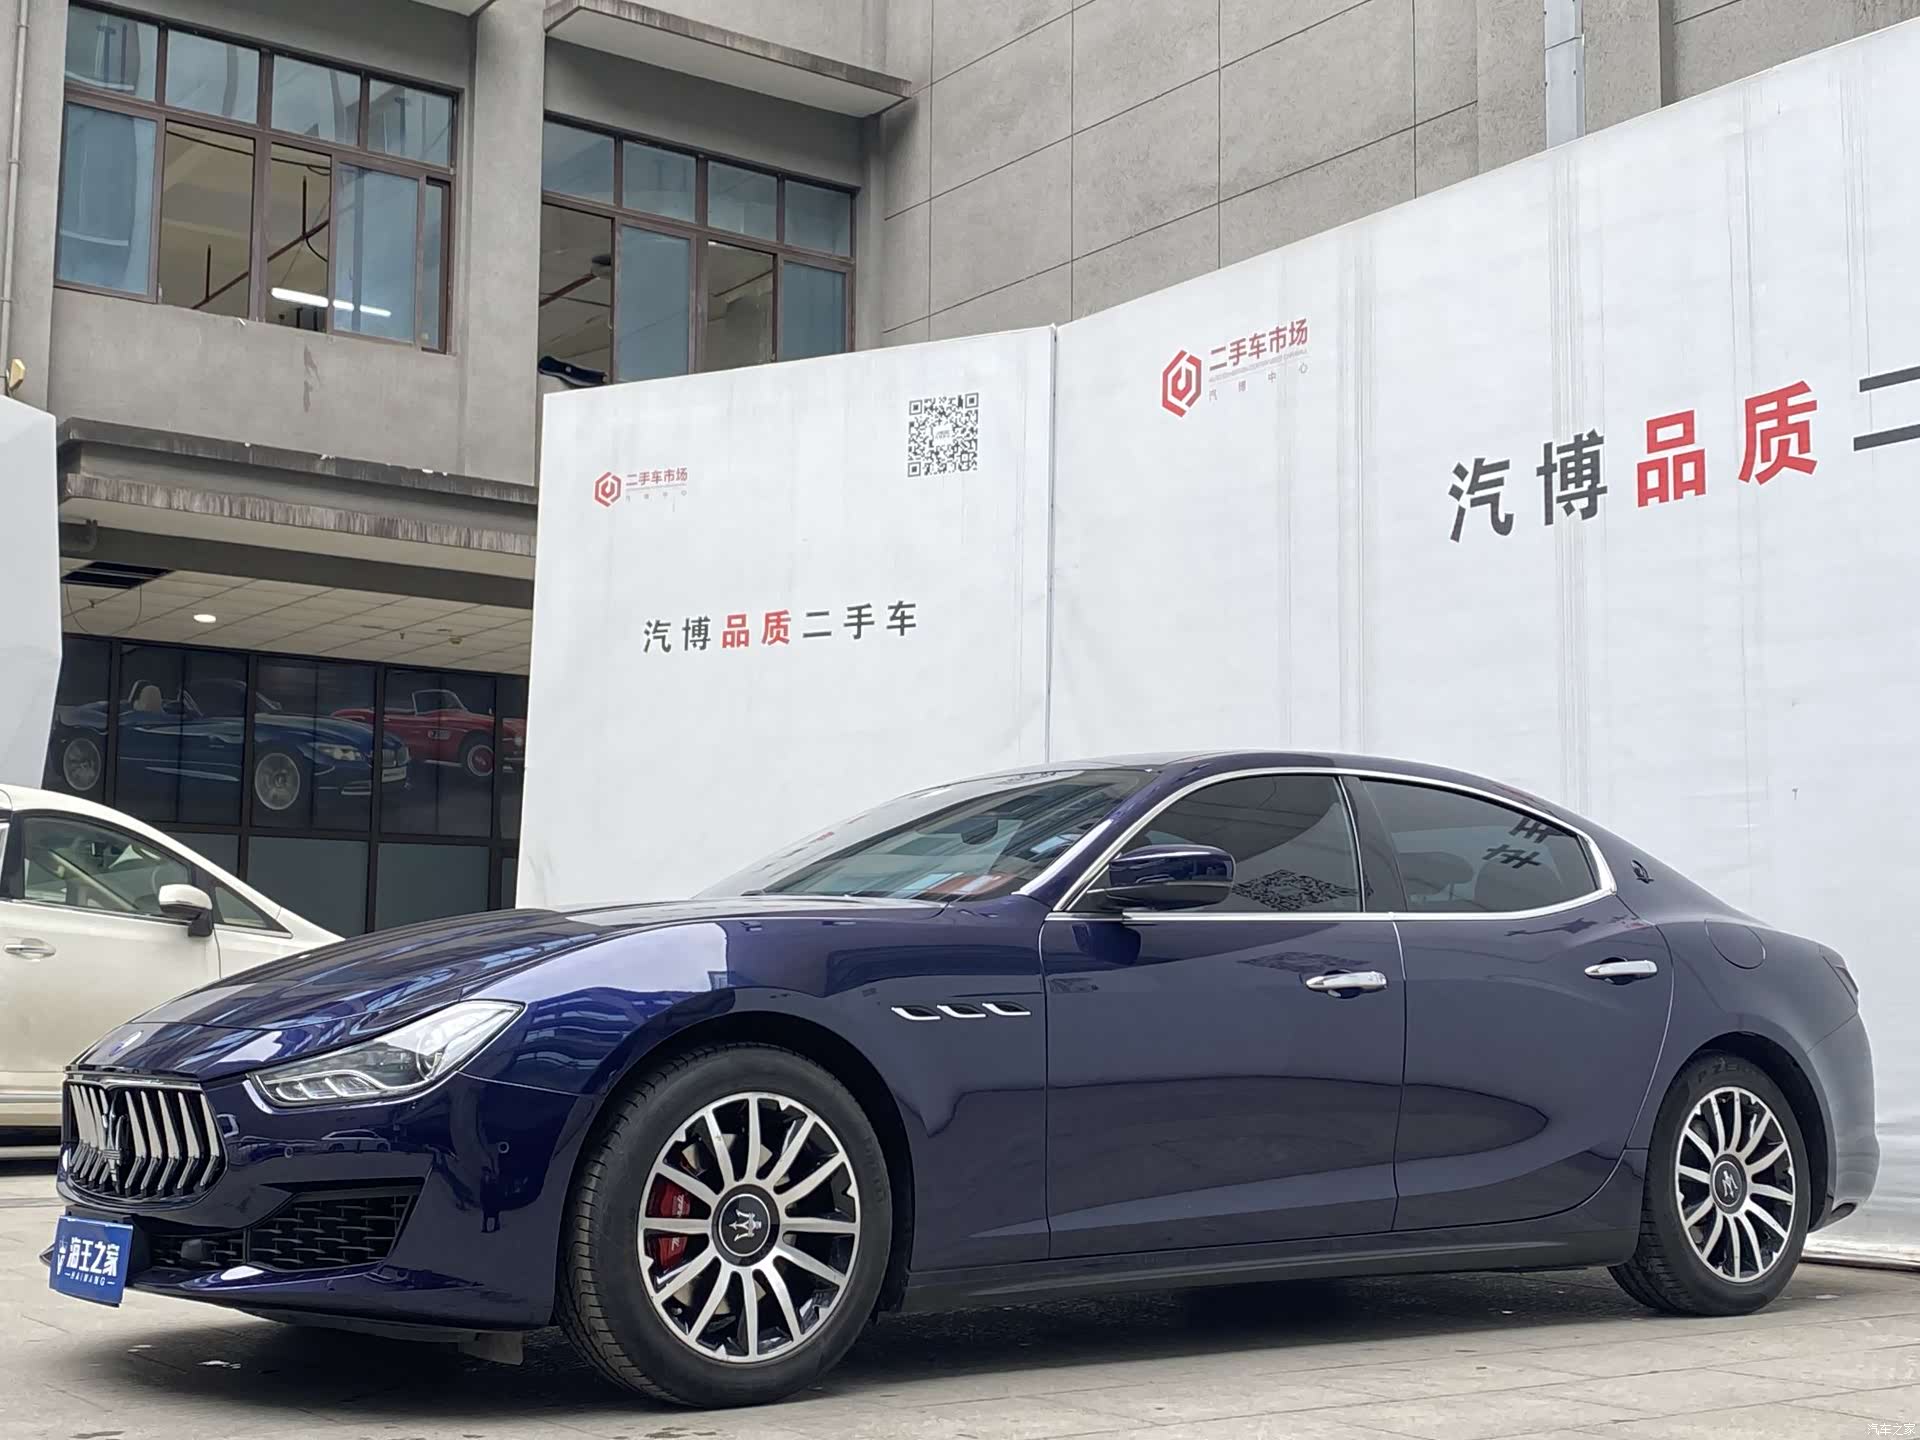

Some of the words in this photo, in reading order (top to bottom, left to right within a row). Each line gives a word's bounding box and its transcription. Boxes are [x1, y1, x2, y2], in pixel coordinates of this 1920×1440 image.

[1209, 318, 1308, 372] 二手车市场
[626, 467, 688, 486] 二手车市场
[642, 600, 918, 654] 汽博品质二手车
